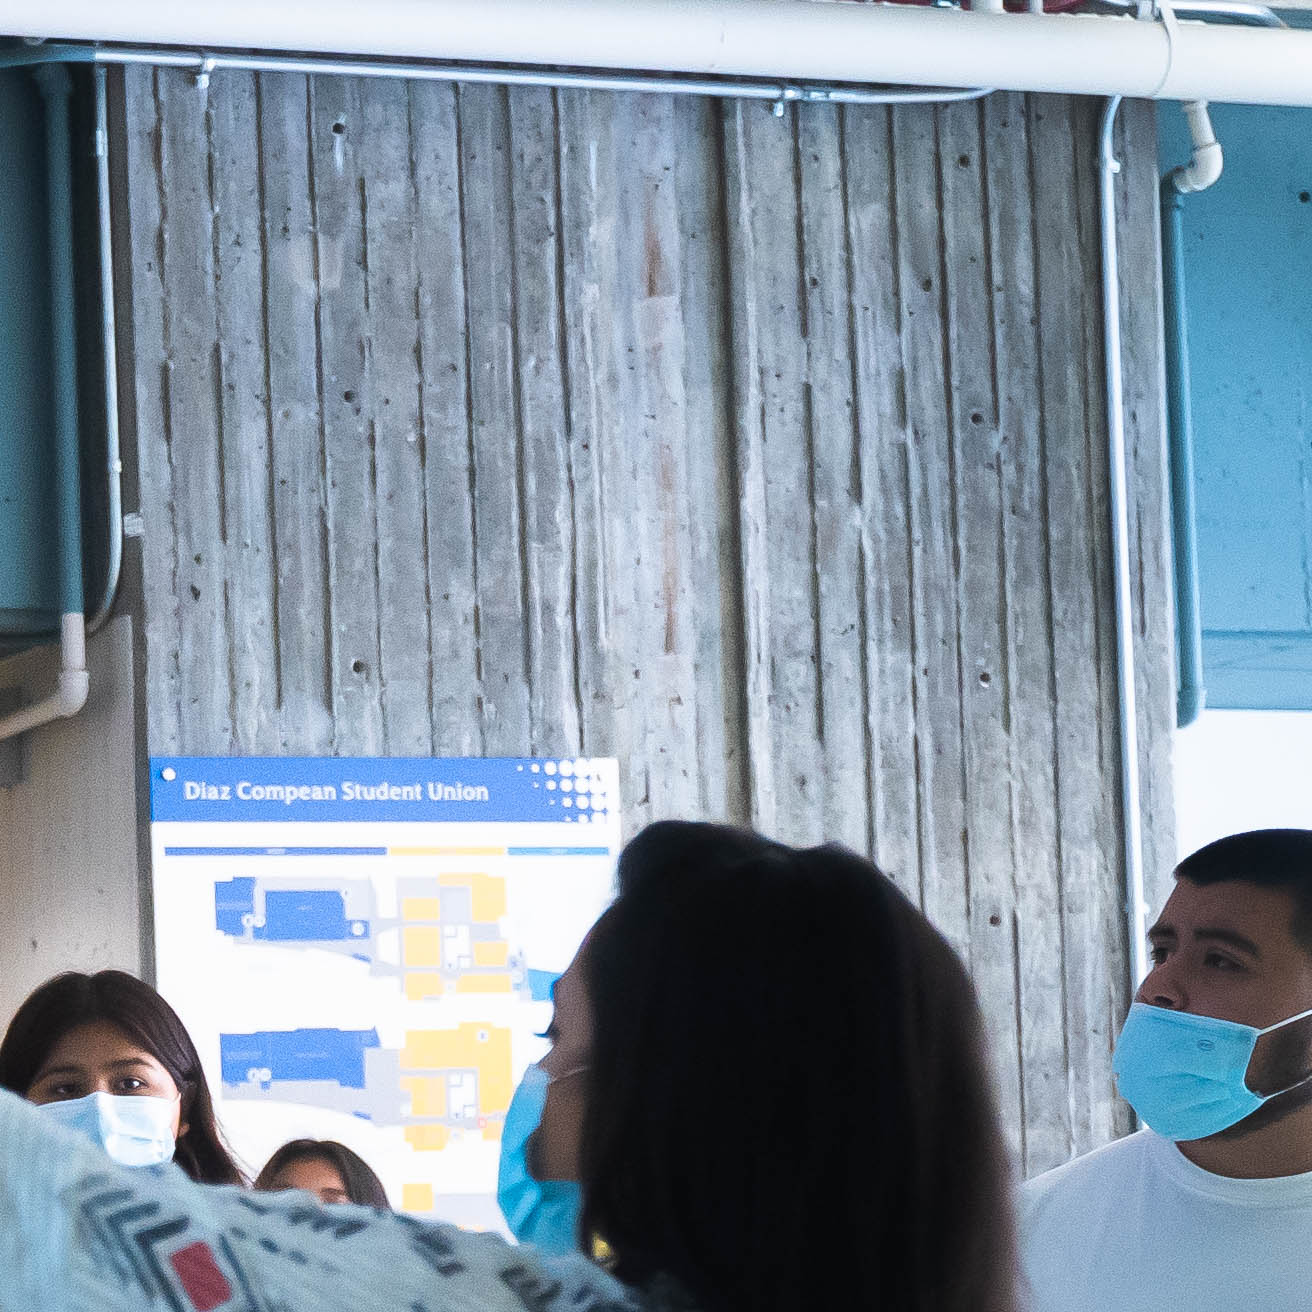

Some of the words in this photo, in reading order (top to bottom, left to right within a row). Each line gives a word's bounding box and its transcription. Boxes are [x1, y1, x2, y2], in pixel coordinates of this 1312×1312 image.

[184, 780, 232, 801] Diaz
[236, 780, 337, 805] Compean
[341, 780, 423, 801] Student
[427, 781, 489, 801] Union
